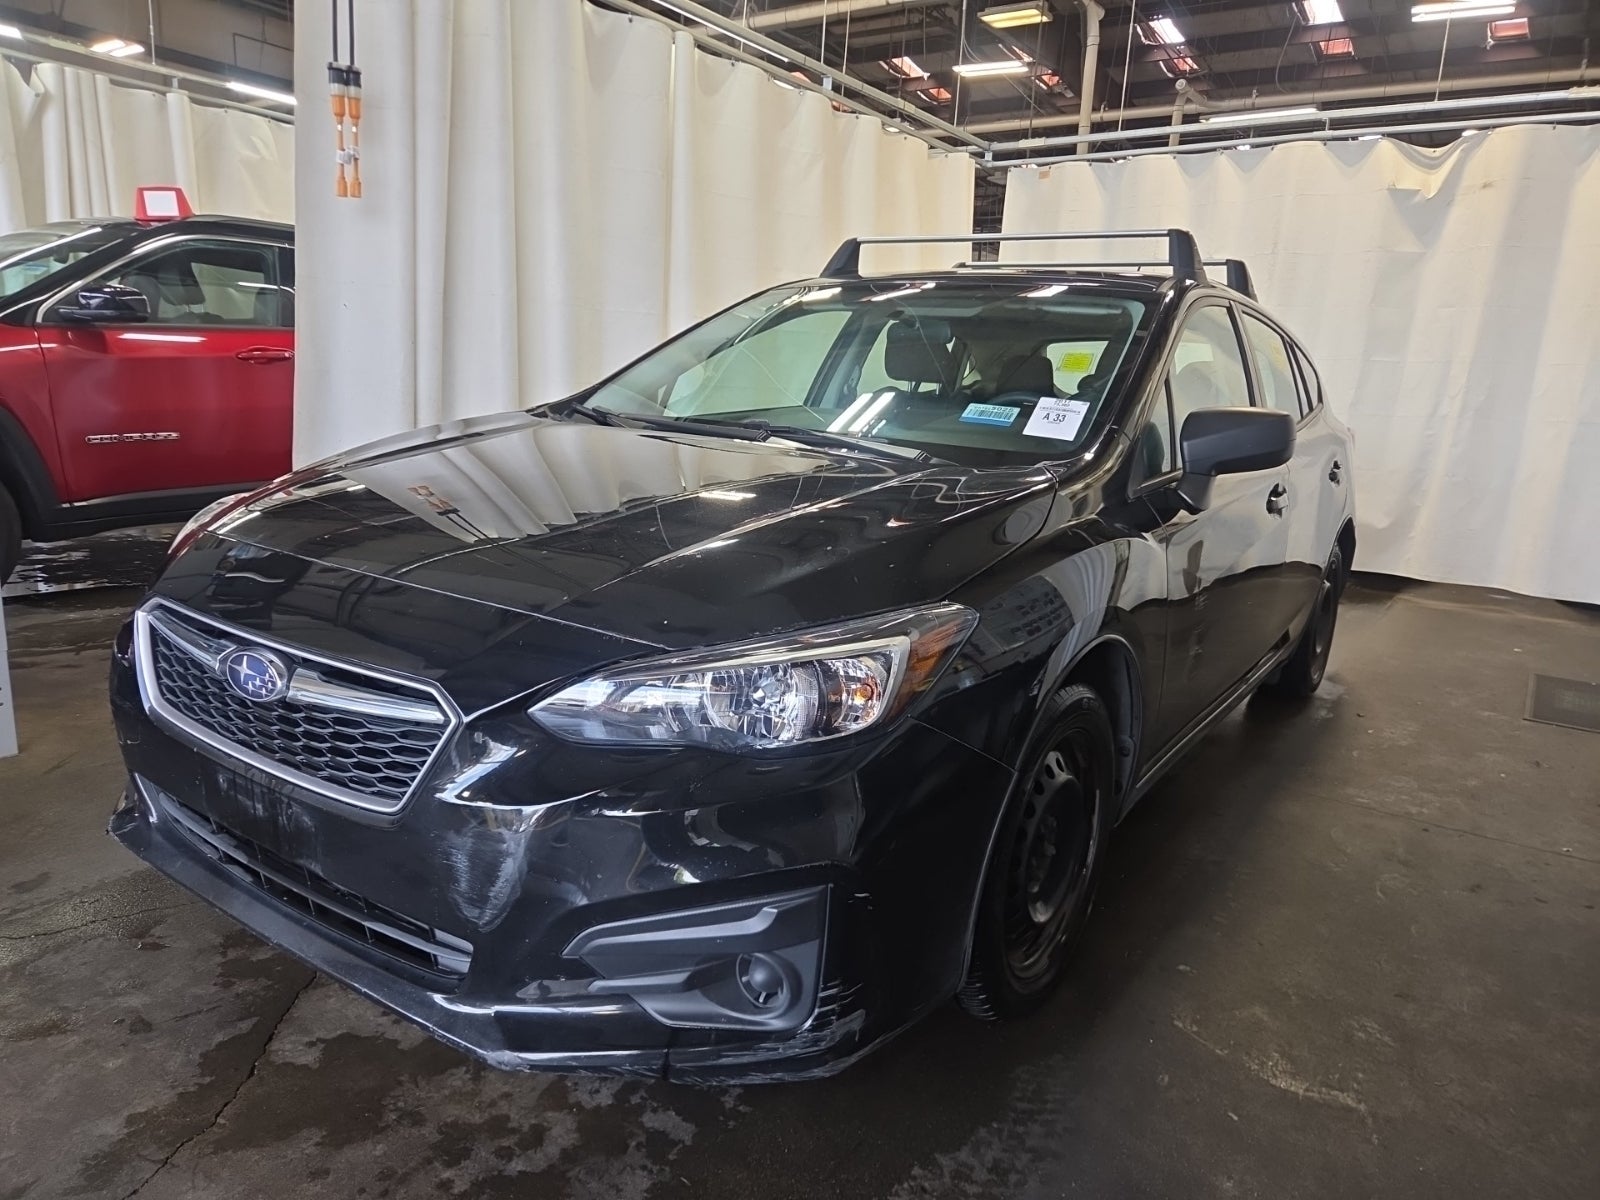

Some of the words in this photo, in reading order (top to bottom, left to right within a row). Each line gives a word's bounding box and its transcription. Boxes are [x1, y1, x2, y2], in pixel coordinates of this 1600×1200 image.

[1042, 412, 1050, 421] A
[1053, 413, 1067, 423] 33
[85, 432, 180, 444] COMPASS
